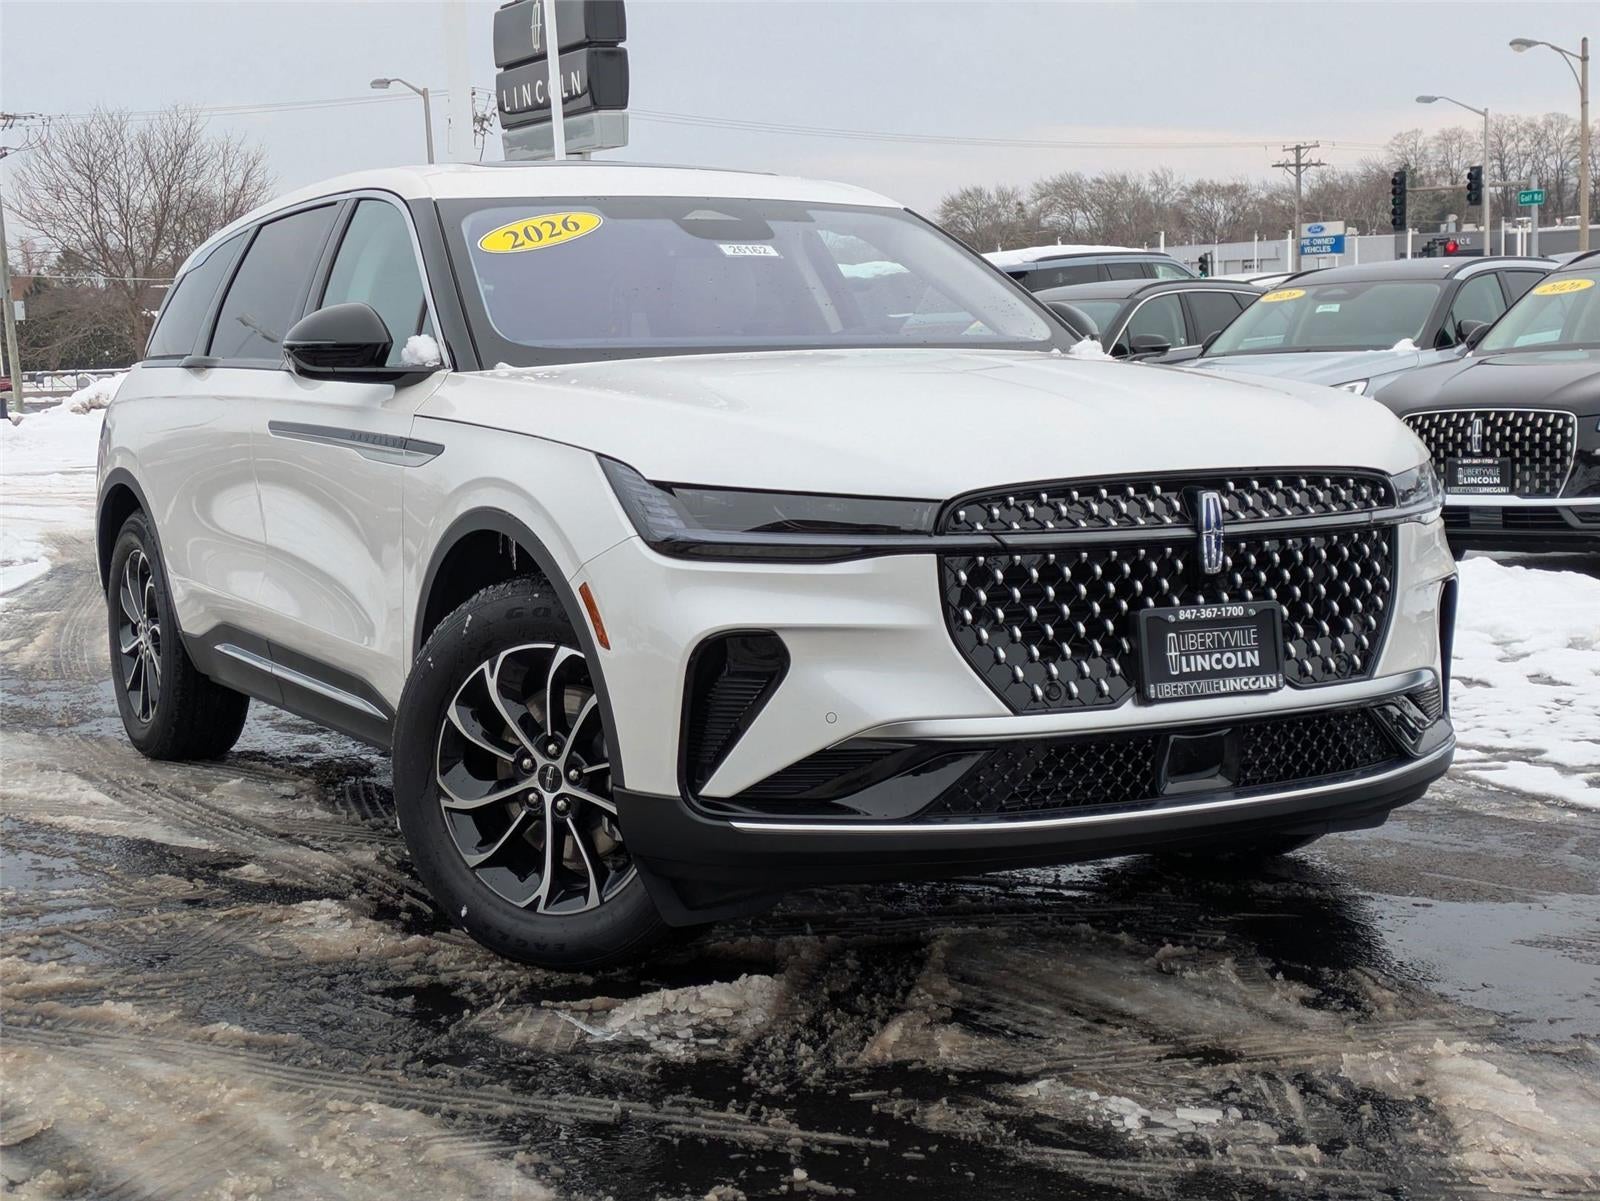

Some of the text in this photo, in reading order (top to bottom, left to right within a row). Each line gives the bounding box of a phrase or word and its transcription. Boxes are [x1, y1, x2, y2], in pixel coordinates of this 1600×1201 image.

[503, 70, 582, 112] LINCLN
[503, 215, 580, 250] 2026
[728, 245, 770, 254] 26162
[1463, 476, 1500, 484] LINCOLN
[1178, 606, 1244, 620] 847-367-1700
[1179, 628, 1258, 651] LIBERTYVILLE
[1181, 650, 1260, 673] LINCOLN
